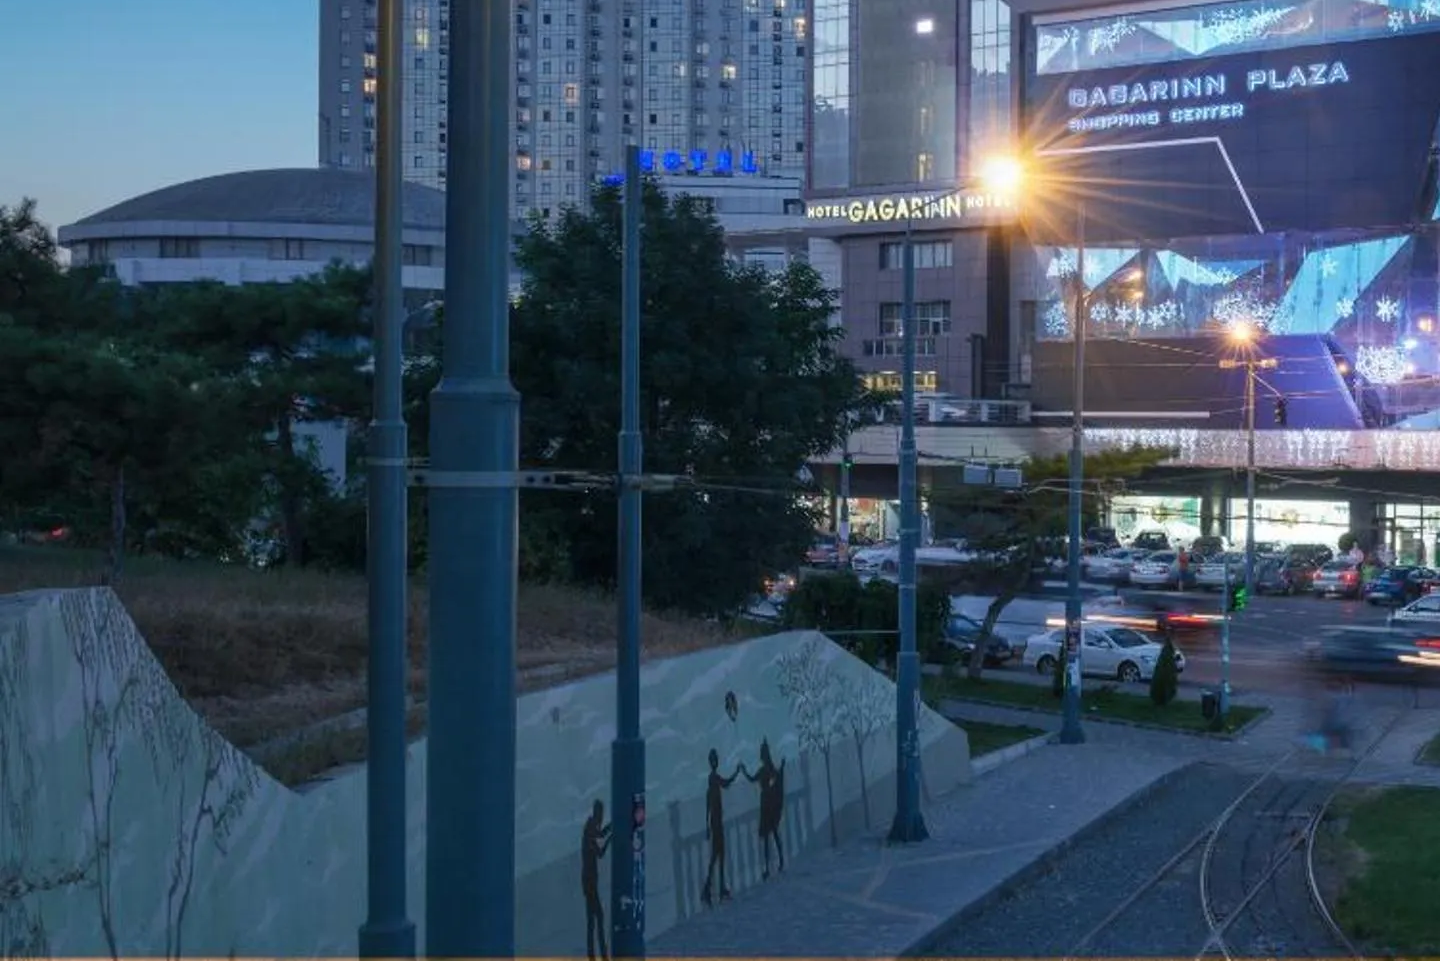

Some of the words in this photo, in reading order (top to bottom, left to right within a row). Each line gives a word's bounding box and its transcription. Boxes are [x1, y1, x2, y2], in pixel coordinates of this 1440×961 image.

[1068, 74, 1227, 108] GAGARINN
[1247, 61, 1350, 92] PLAZA
[1068, 110, 1161, 132] SHOPPING
[1169, 102, 1245, 124] CENTER
[807, 207, 848, 219] HOTEL
[849, 195, 962, 223] GAGARINN
